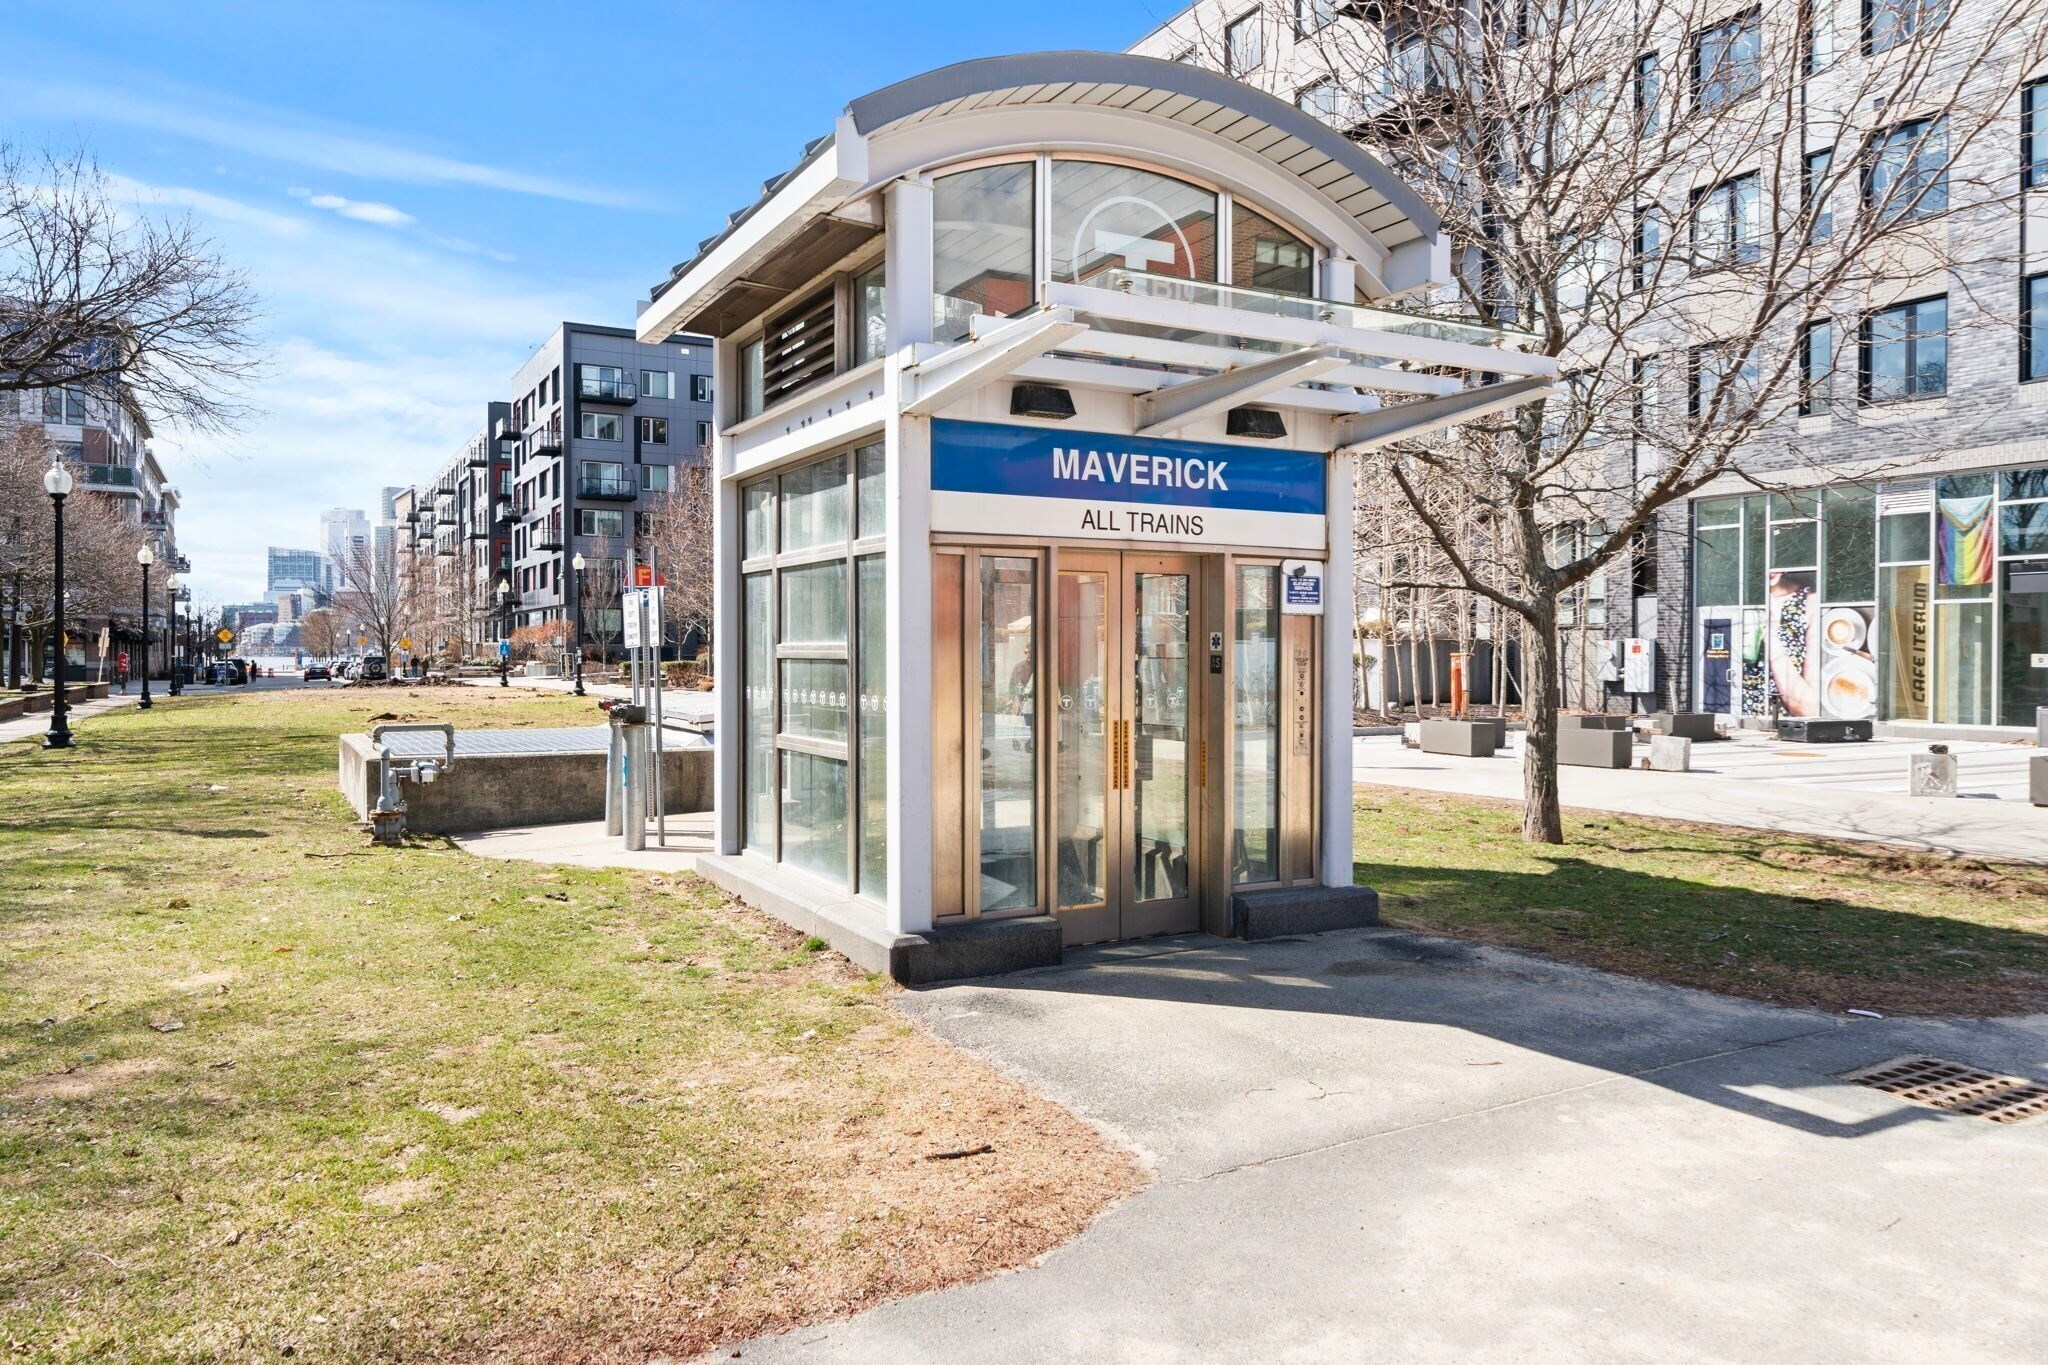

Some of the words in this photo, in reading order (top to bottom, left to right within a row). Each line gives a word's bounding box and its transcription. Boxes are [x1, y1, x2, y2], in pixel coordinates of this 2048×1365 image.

[1052, 447, 1229, 491] MAVERICK
[1080, 508, 1121, 532] ALL
[1126, 511, 1204, 536] TRAINS
[1913, 583, 1927, 653] ITERUM
[1912, 655, 1925, 703] CAFE
